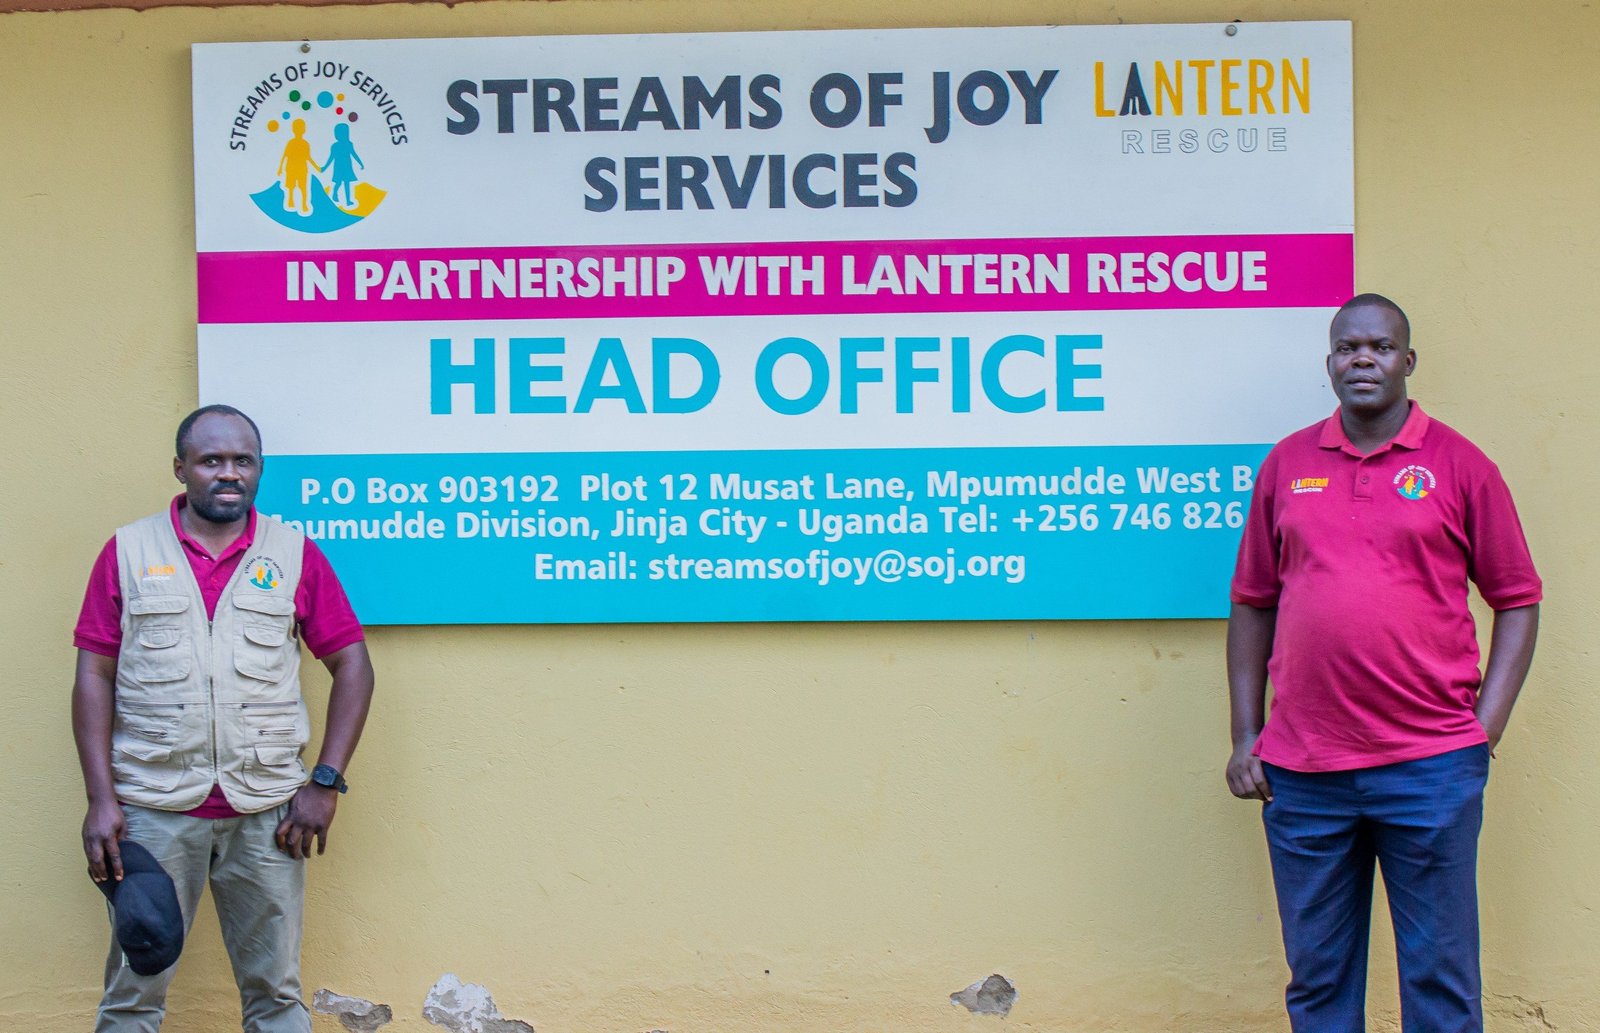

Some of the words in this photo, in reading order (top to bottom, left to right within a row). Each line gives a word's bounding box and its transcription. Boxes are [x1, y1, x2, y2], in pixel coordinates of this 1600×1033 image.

[230, 73, 283, 150] STREAMS
[285, 62, 308, 82] OF
[313, 61, 349, 80] JOY
[349, 70, 408, 145] SERVICES
[446, 74, 782, 135] STREAMS
[810, 73, 902, 128] OF
[924, 70, 1059, 143] JOY
[1094, 57, 1310, 117] LANTERN
[1121, 127, 1287, 154] RESCUE
[584, 152, 918, 213] SERVICES
[286, 260, 338, 300] IN
[354, 257, 686, 300] PARTNERSHIP
[699, 255, 825, 296] WITH
[842, 253, 1070, 295] LANTERN
[1087, 251, 1268, 293] RESCUE
[430, 337, 721, 415] HEAD
[755, 334, 1105, 415] OFFICE
[301, 478, 356, 505] P.O
[367, 477, 429, 504] Box
[439, 475, 559, 503] 903192
[581, 473, 648, 501] Plot
[659, 474, 698, 501] 12
[709, 474, 815, 501] Musat
[825, 473, 914, 502] Lane,
[927, 467, 1126, 505] Mpumudde
[1136, 467, 1221, 494] West
[271, 513, 446, 540] umudde
[456, 510, 600, 541] Division,
[610, 507, 687, 544] Jinja
[699, 507, 767, 544] City
[798, 506, 928, 543] Uganda
[938, 505, 998, 533] Tel:
[1012, 503, 1099, 532] +256
[1110, 502, 1171, 530] 746
[1183, 501, 1244, 530] 826
[535, 551, 637, 580] Email:
[648, 548, 1025, 586] streamsofjoy@soj.org
